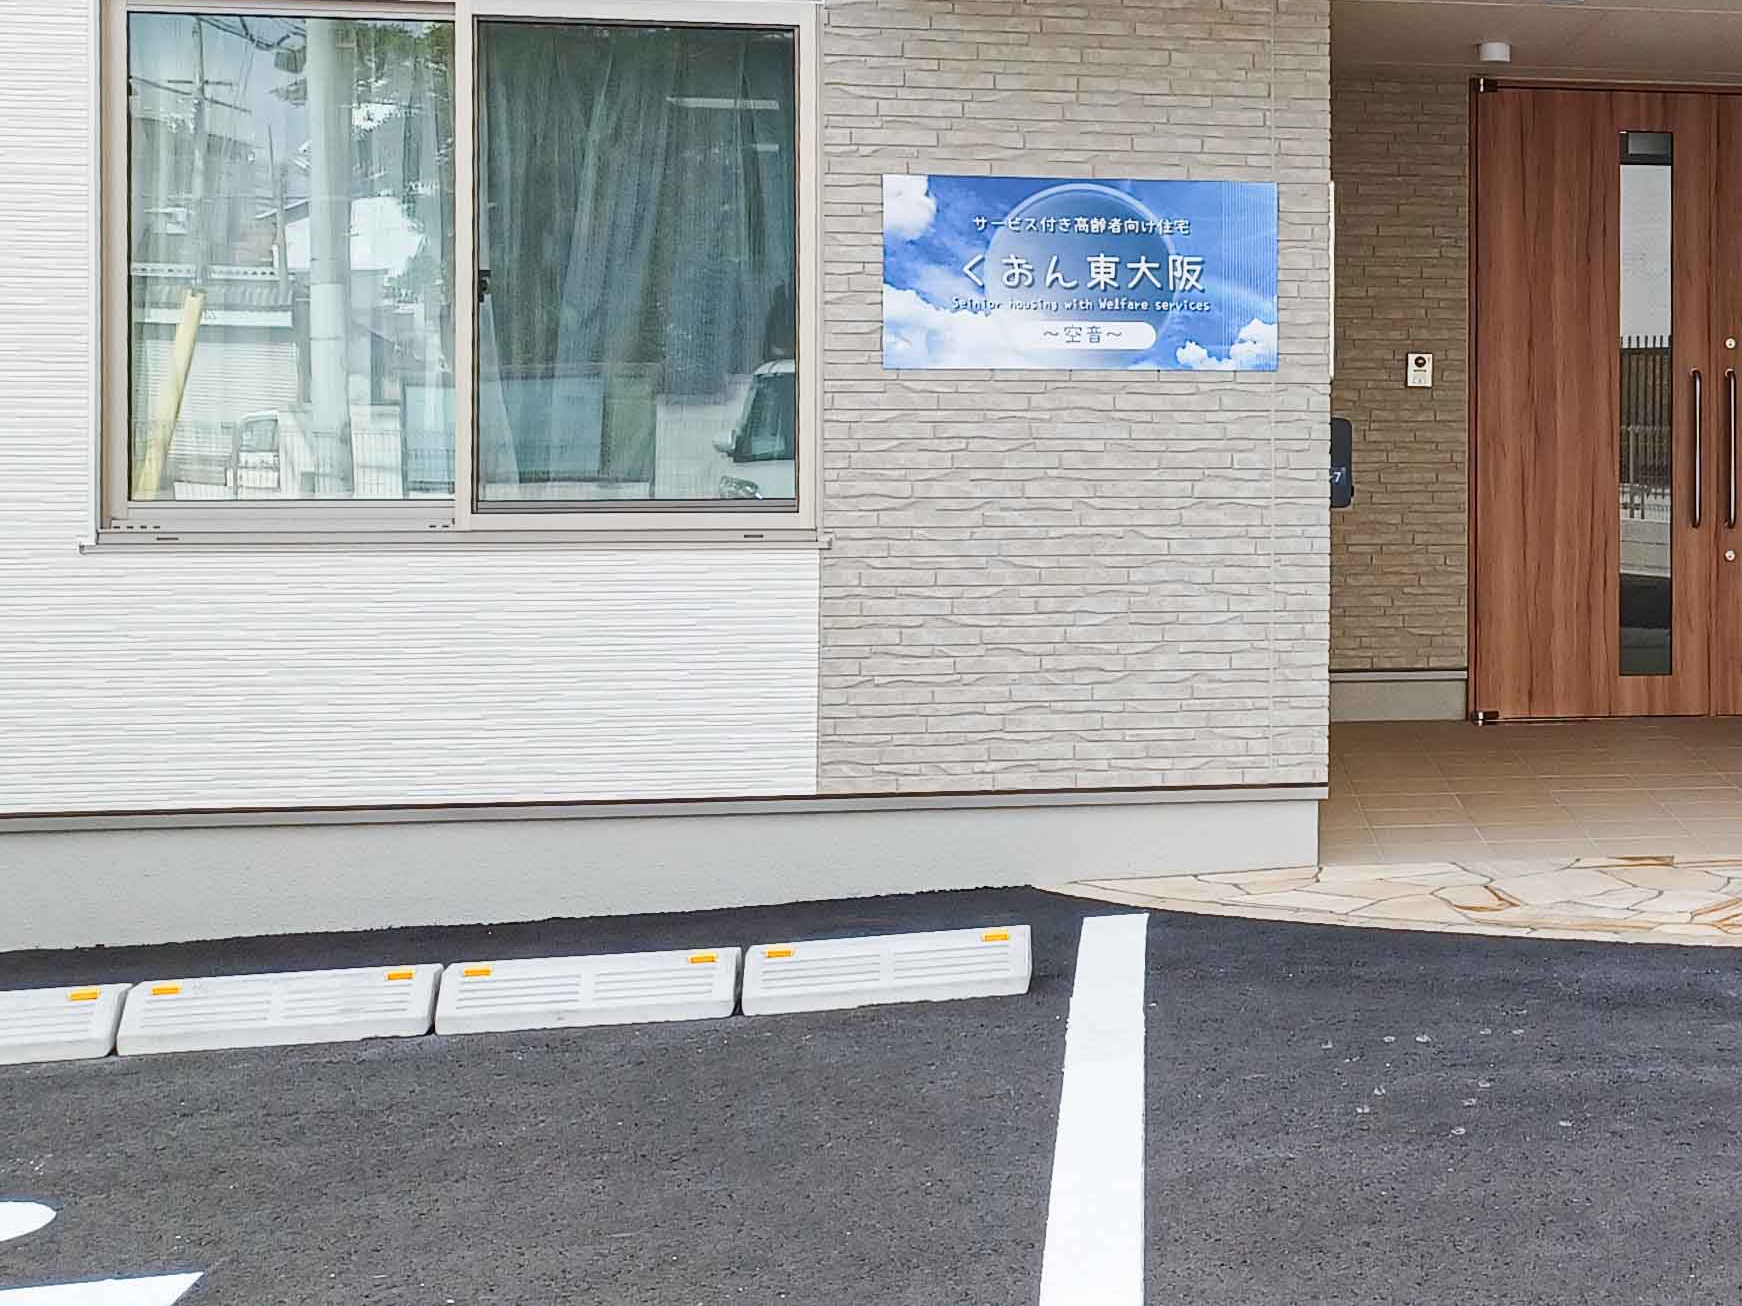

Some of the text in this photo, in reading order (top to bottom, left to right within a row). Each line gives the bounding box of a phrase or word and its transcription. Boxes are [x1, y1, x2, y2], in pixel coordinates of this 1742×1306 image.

[973, 216, 1191, 235] サービス付き高齢者向け住宅
[962, 253, 1206, 293] くおん東大阪
[1009, 298, 1059, 313] housing
[1064, 298, 1093, 311] with
[1099, 298, 1148, 312] Welfare
[1155, 299, 1211, 312] services
